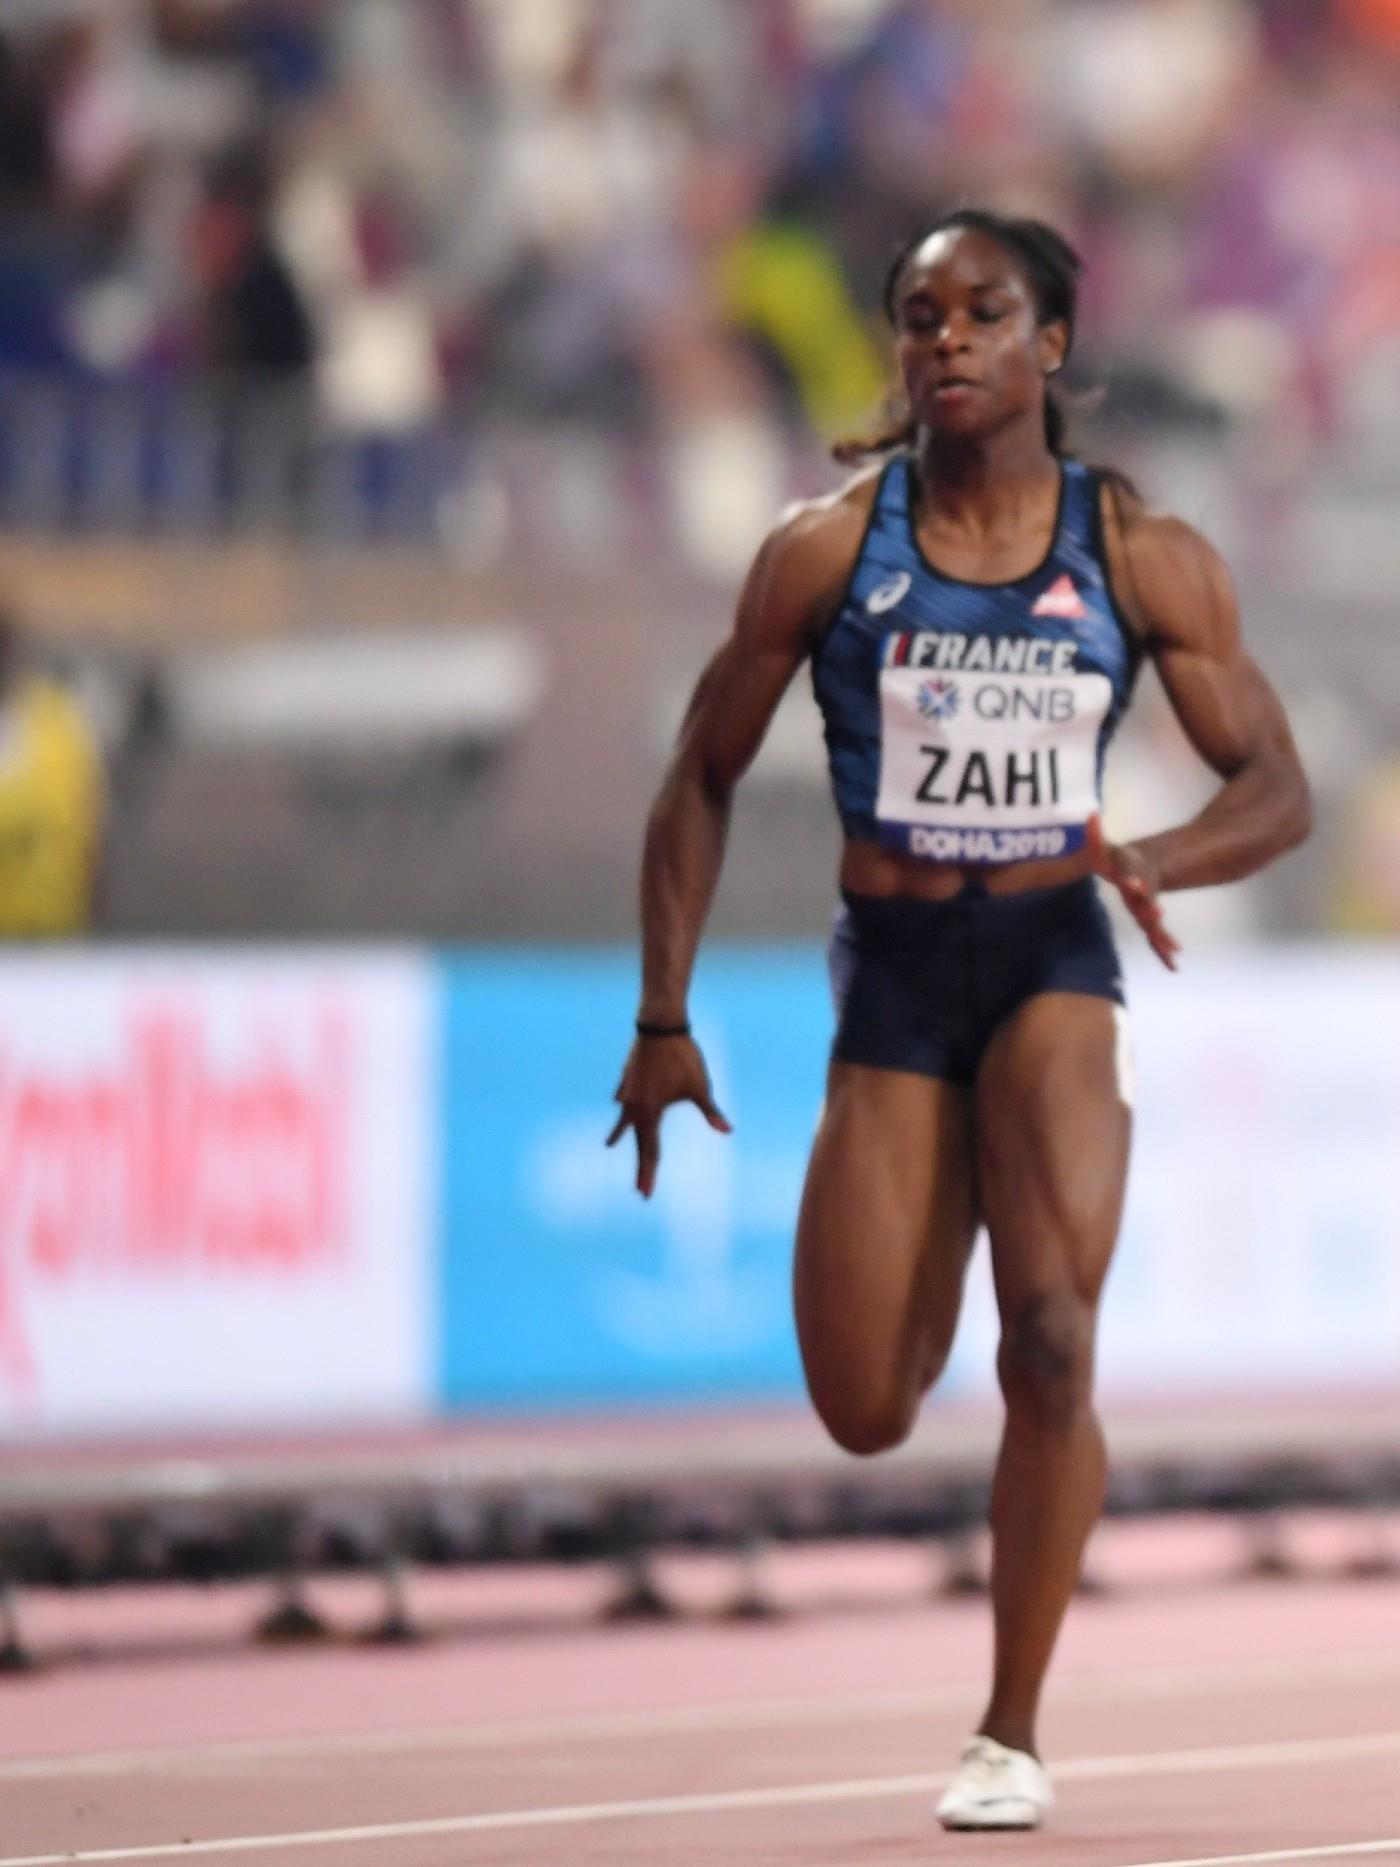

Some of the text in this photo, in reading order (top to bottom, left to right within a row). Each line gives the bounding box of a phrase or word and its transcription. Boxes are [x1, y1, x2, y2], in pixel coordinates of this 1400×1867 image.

[911, 633, 1078, 674] FRANCE
[974, 684, 1076, 722] QNB
[915, 745, 1060, 807] ZAHI
[910, 827, 1066, 861] DOHA2019
